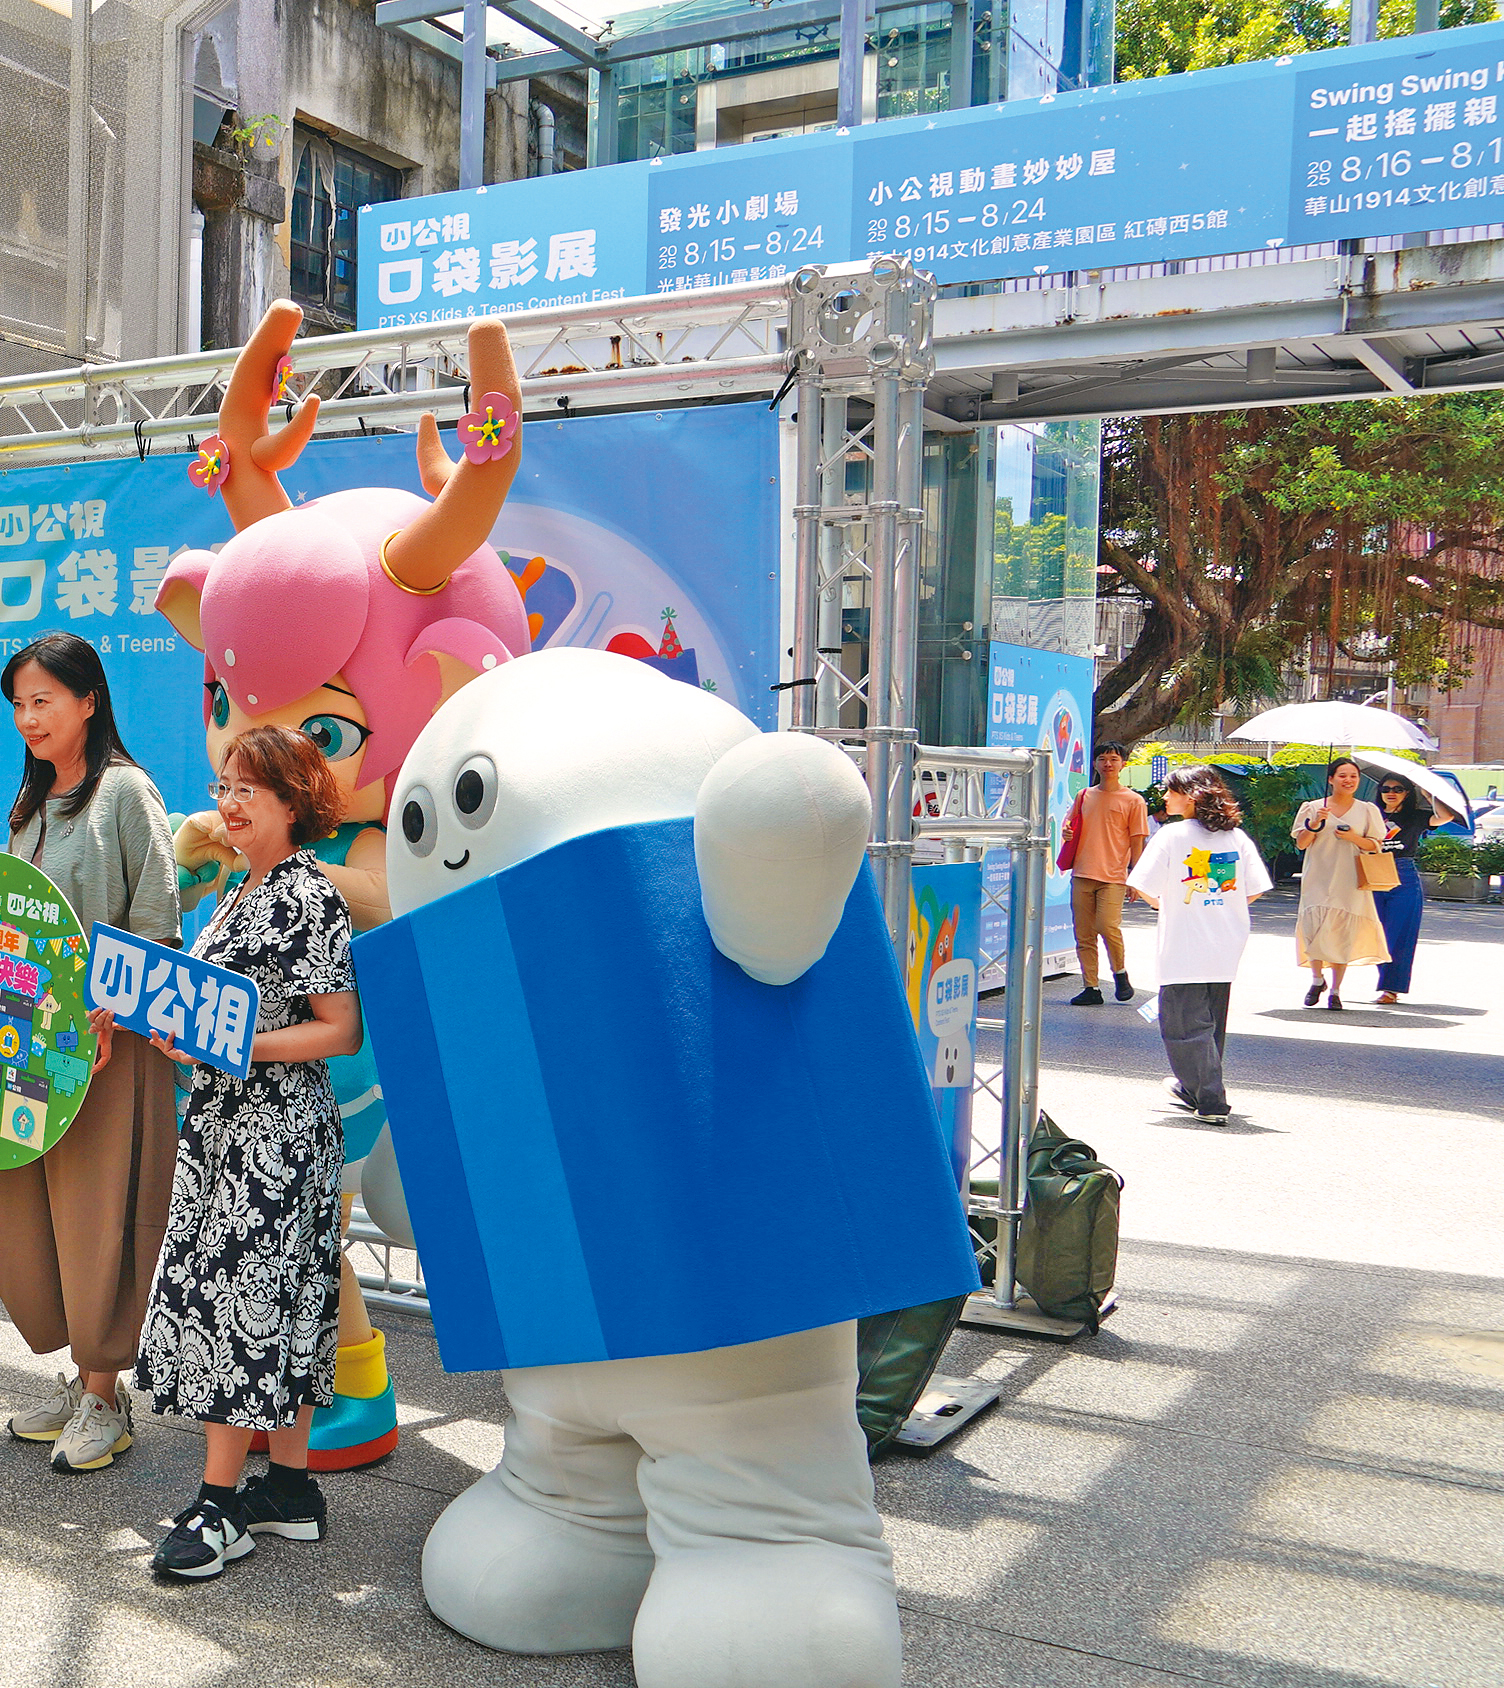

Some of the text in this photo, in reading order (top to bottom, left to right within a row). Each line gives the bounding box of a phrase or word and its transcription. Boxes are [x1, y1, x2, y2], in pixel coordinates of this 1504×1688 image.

[1310, 82, 1394, 110] Swing
[1400, 67, 1489, 96] Swing
[1308, 95, 1497, 142] 一起搖擺親
[868, 148, 1115, 207] 小公視動畫妙妙屋
[380, 212, 471, 252] 小公視
[659, 189, 799, 234] 發光小劇場
[1124, 209, 1228, 240] 紅磚西5館
[378, 228, 598, 306] 口袋影展
[379, 286, 626, 329] PTS XS Kids & Teens Content Fest
[100, 635, 112, 653] &
[117, 634, 176, 653] Teens
[7, 892, 59, 925] 小公視
[90, 933, 250, 1066] 小公視
